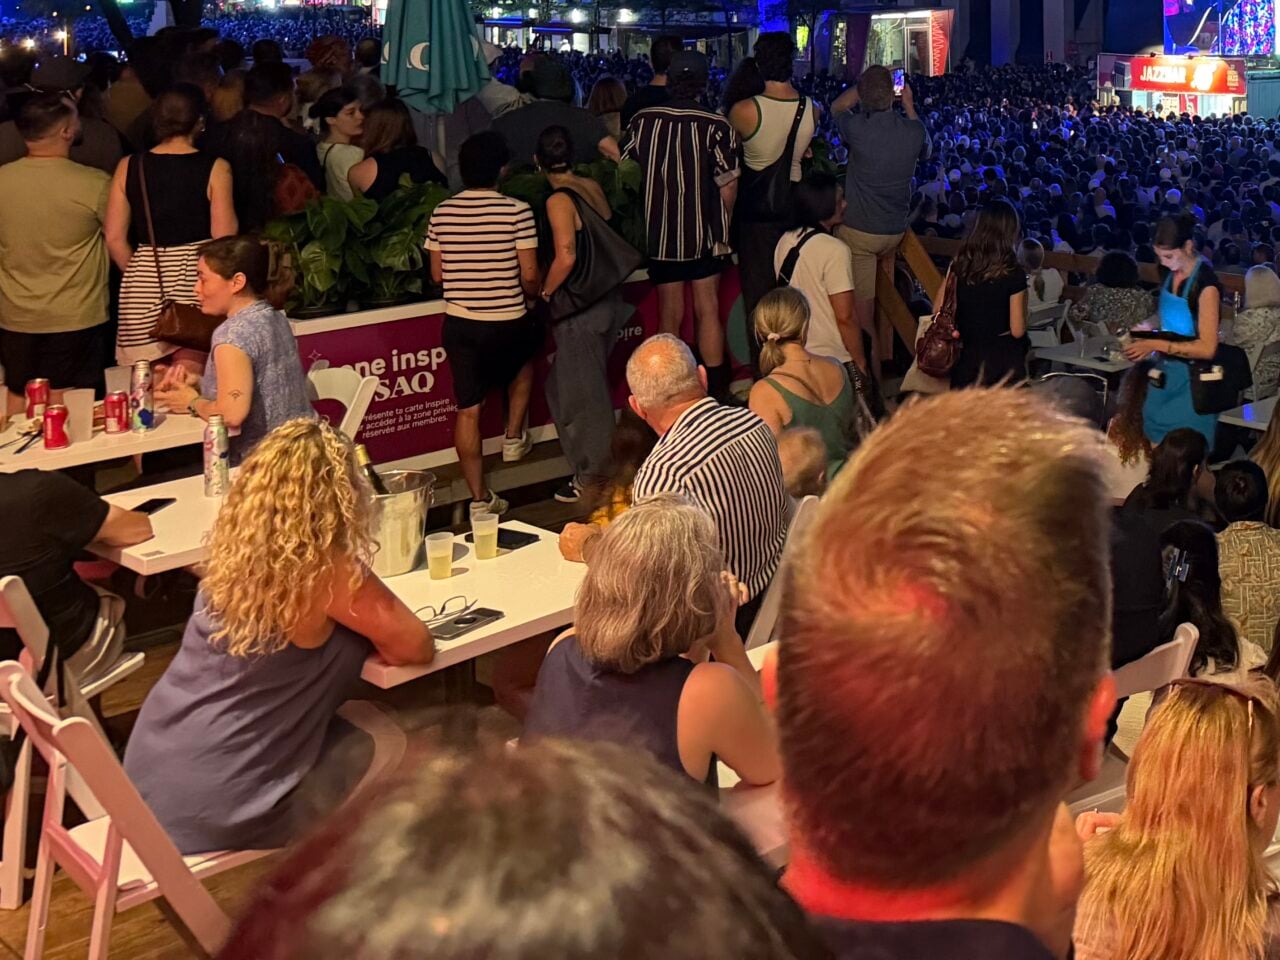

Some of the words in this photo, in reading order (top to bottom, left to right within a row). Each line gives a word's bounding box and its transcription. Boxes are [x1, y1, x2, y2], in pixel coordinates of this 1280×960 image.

[341, 358, 386, 376] ne
[375, 371, 434, 402] SAQ
[364, 410, 394, 421] résente
[404, 403, 424, 413] carte
[366, 417, 396, 430] accéder
[413, 409, 432, 420] zone
[362, 425, 395, 439] réservée
[397, 423, 410, 431] aux
